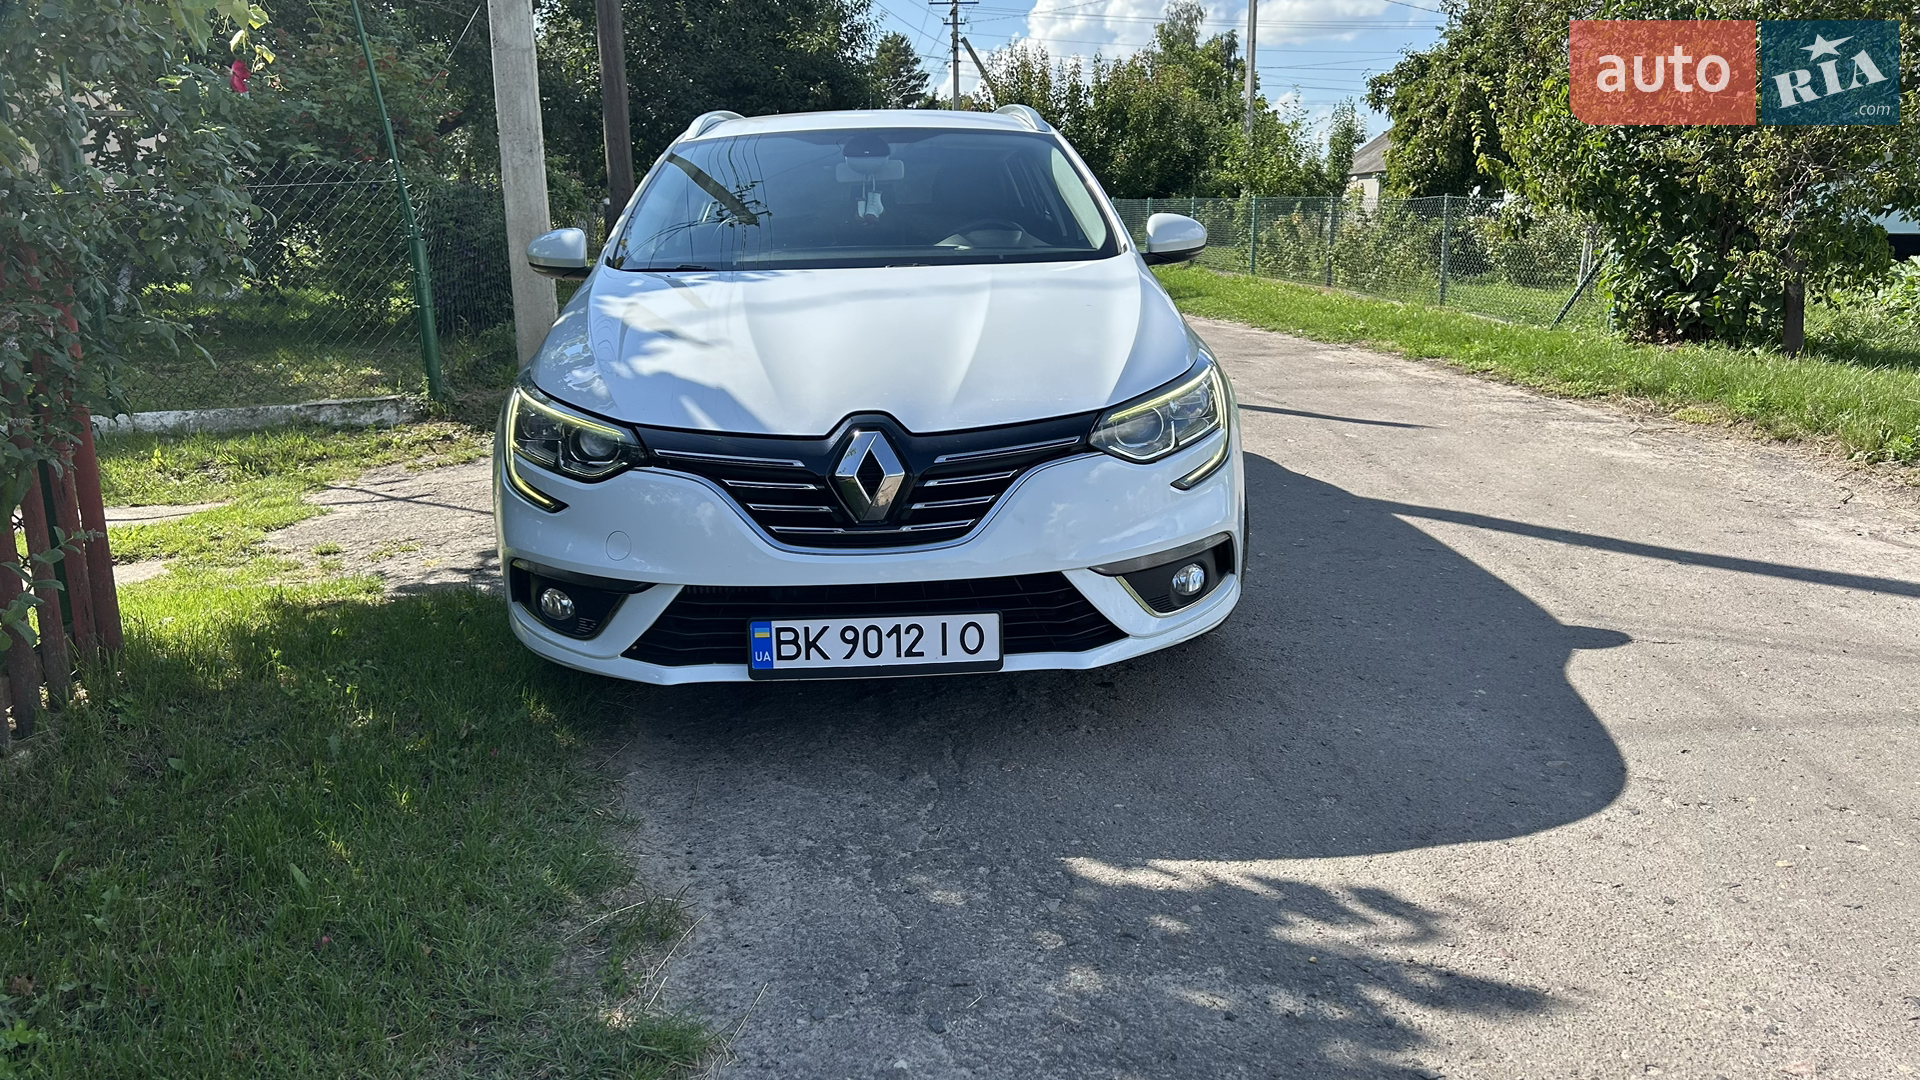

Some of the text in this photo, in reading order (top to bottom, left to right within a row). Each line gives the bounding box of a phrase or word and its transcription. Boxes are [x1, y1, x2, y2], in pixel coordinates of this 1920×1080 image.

[775, 625, 831, 661] BK
[839, 623, 925, 660] 9012
[755, 651, 772, 662] UA
